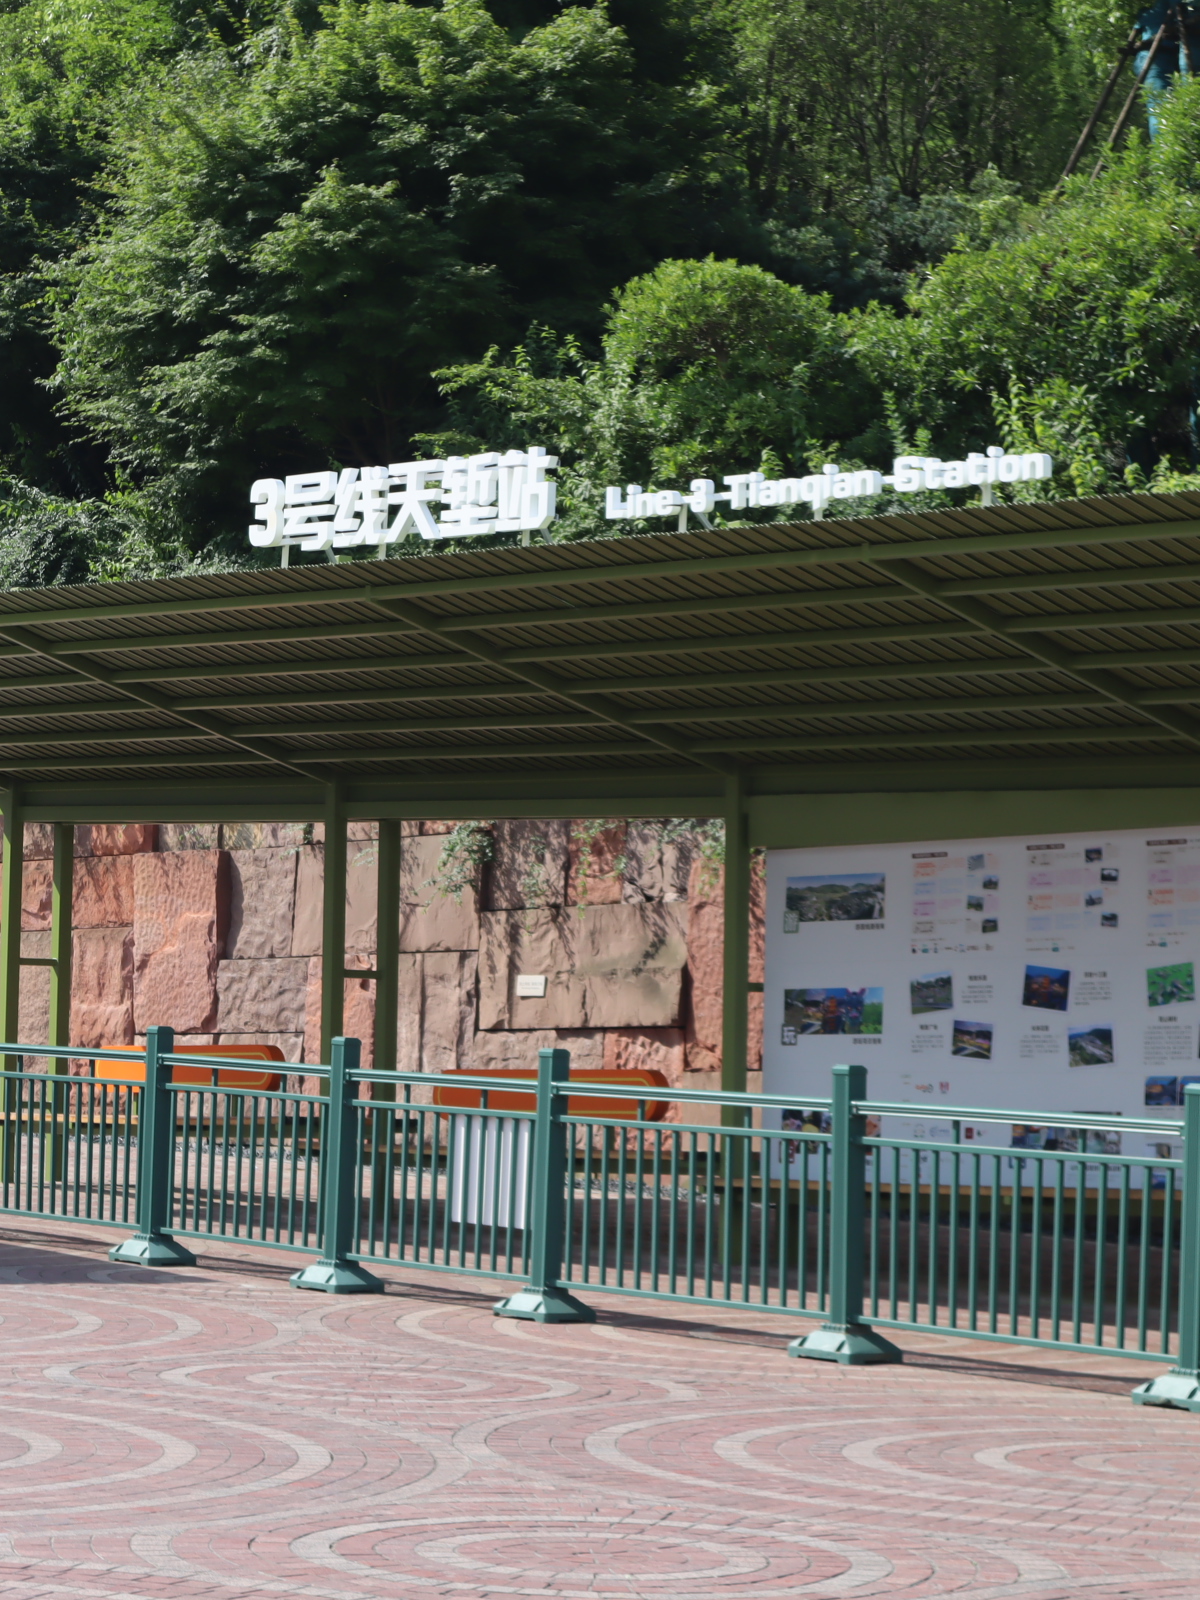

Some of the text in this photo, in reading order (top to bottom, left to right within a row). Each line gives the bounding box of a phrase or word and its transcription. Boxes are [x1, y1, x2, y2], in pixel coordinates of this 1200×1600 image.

[249, 446, 558, 551] 3号线天堑站
[606, 446, 1052, 519] Line 3 Tianqian Station
